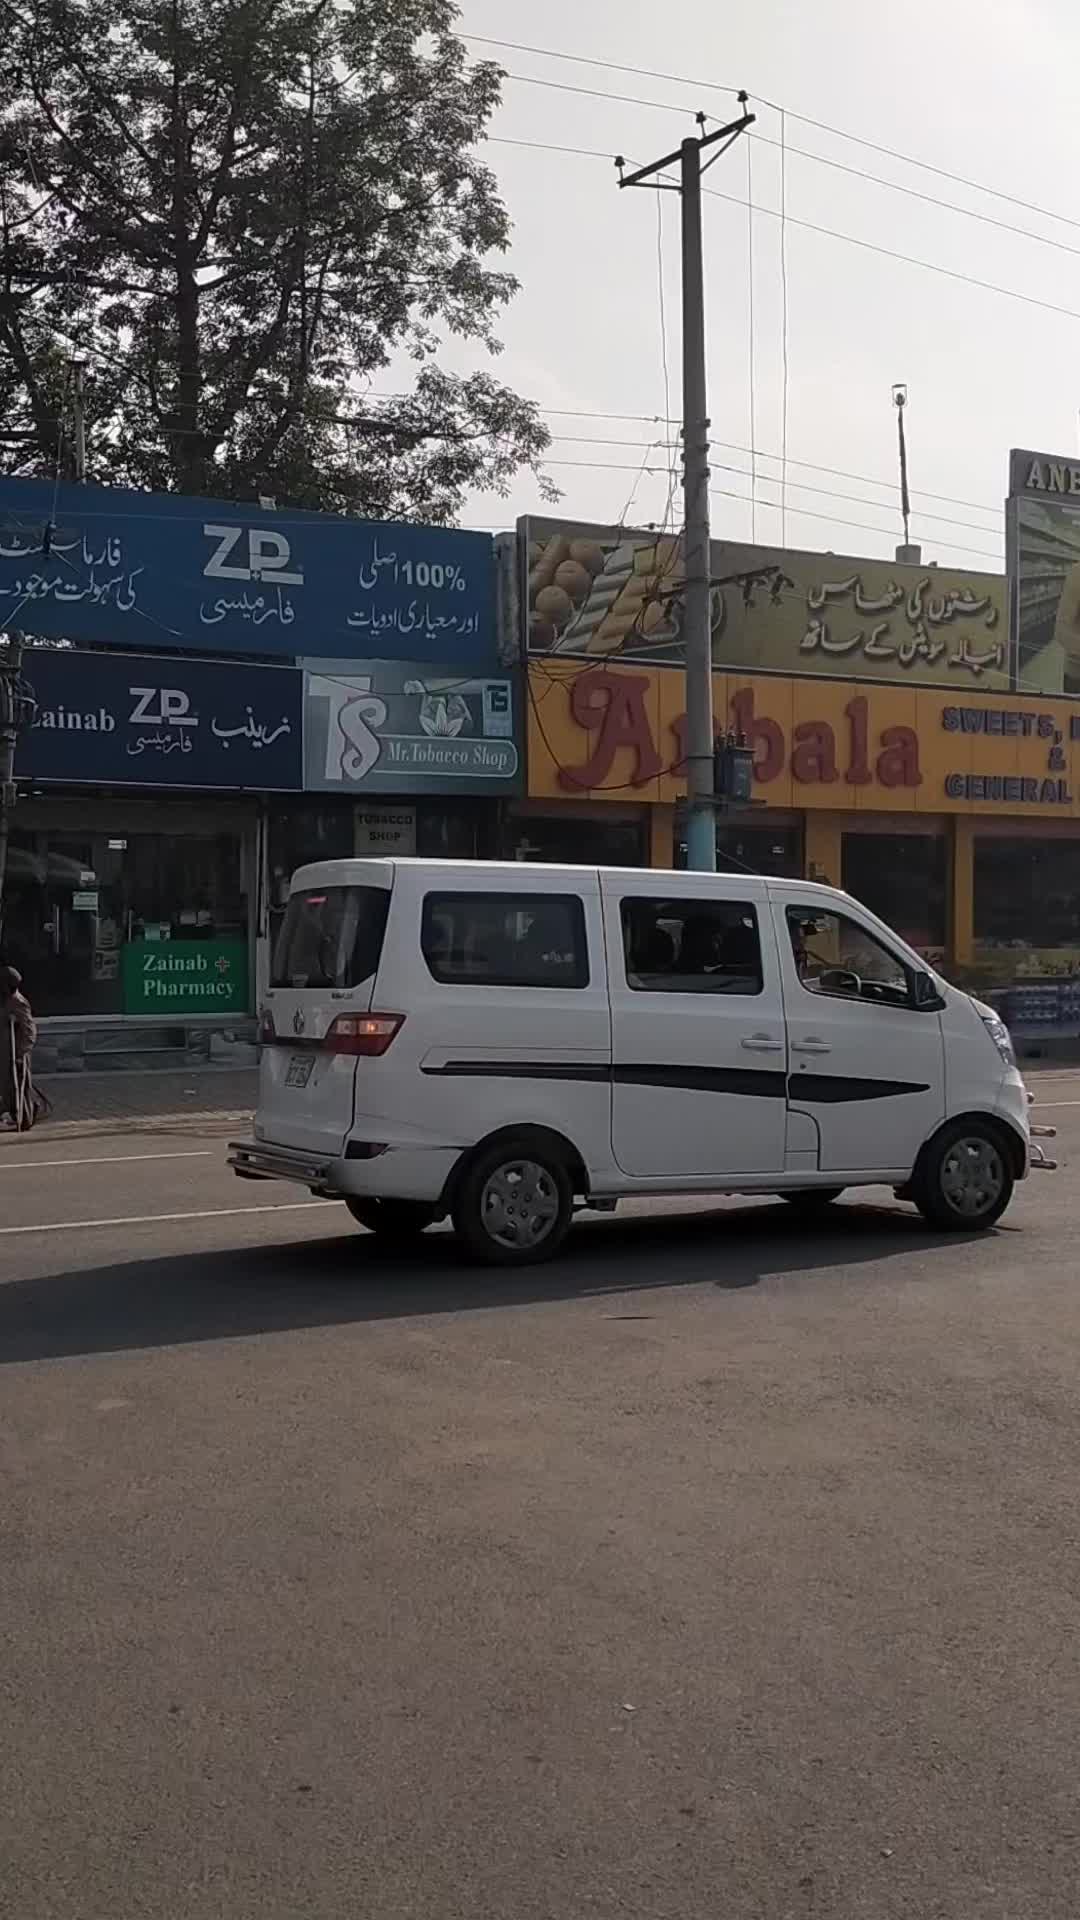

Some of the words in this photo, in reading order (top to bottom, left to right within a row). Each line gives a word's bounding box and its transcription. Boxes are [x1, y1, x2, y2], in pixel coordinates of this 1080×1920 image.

[203, 523, 304, 585] ZP
[359, 535, 399, 589] اصلی
[54, 569, 125, 604] سہولت
[401, 560, 466, 591] 100%
[455, 611, 480, 634] اور
[128, 687, 199, 726] ZP
[211, 705, 291, 748] زینب
[472, 744, 508, 770] Shop
[944, 773, 1073, 804] GENERAL
[369, 830, 401, 841] SHOP
[143, 954, 208, 972] Zainab
[143, 979, 233, 999] Pharmacy
